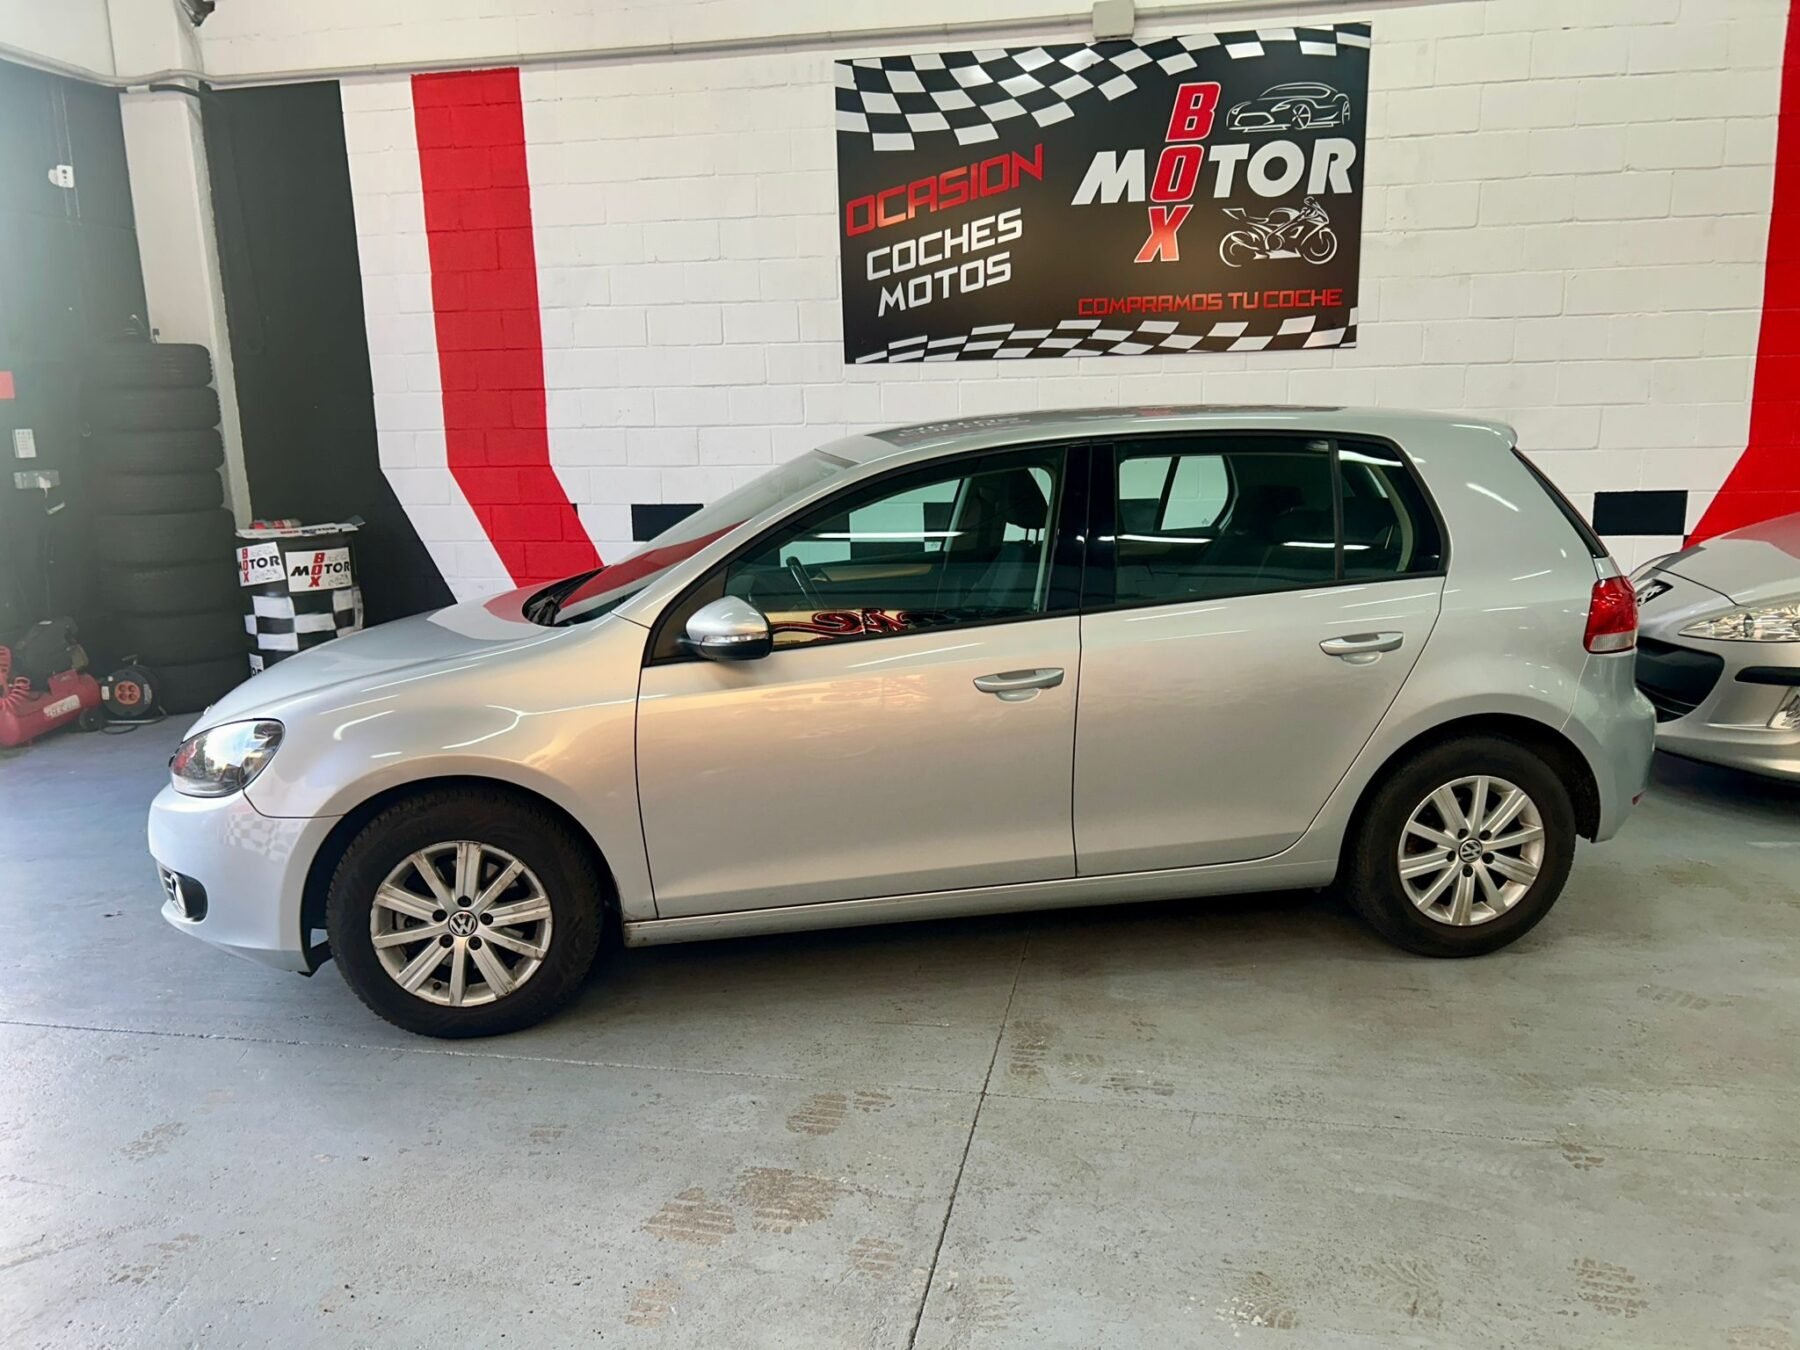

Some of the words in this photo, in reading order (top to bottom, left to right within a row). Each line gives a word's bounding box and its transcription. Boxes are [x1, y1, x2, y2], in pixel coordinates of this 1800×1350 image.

[845, 143, 1045, 238] OCASION
[1071, 138, 1357, 206] MOTOR
[1134, 81, 1221, 263] BOX
[866, 207, 1023, 281] COCHES
[877, 251, 1012, 317] MOTOS
[1077, 291, 1223, 316] COMPRAMOS
[1227, 290, 1260, 312] TU
[1262, 288, 1343, 310] COCHE
[290, 561, 350, 577] MOTOR
